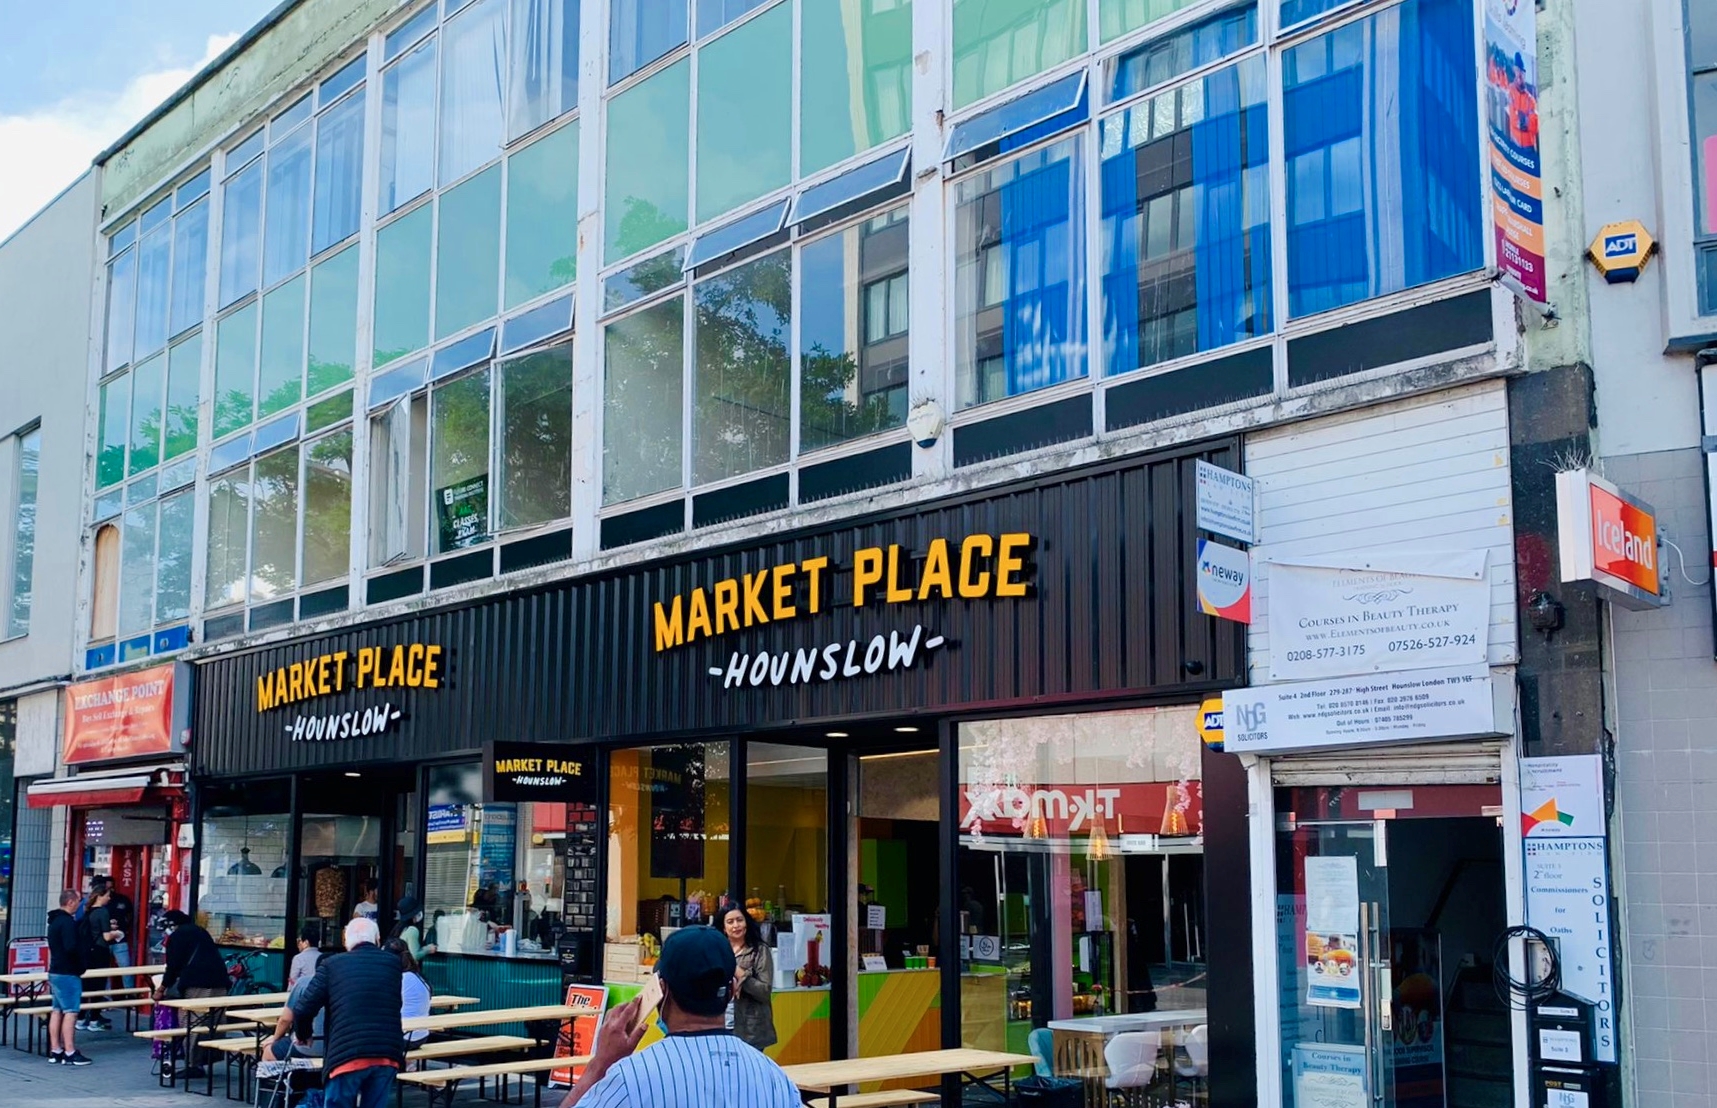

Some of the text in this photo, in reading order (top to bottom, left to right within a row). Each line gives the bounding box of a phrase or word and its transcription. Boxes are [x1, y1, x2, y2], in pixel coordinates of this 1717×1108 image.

[1605, 236, 1637, 254] ADT
[1207, 468, 1251, 493] HAMPTONS
[1597, 508, 1653, 570] Iceland
[653, 532, 1031, 652] MARKET PLACE
[1287, 634, 1476, 662] 0208-577-3175 07526-527-924
[258, 643, 441, 713] MARKET PLACE
[1312, 690, 1326, 698] Floor
[1355, 686, 1370, 694] High
[1370, 684, 1388, 692] Street
[1391, 681, 1420, 690] Hounslow
[1422, 678, 1445, 687] London
[74, 679, 165, 711] EXCHANGE POINT
[1237, 732, 1268, 742] SOLICITORS
[495, 758, 582, 776] MARKET PLACE
[1537, 842, 1603, 851] HAMPTONS
[122, 849, 133, 887] FAST
[1592, 877, 1611, 1047] SOLICITORS
[571, 994, 591, 1006] The
[1312, 1051, 1342, 1061] Courses
[1303, 1061, 1362, 1074] Beauty Therapy
